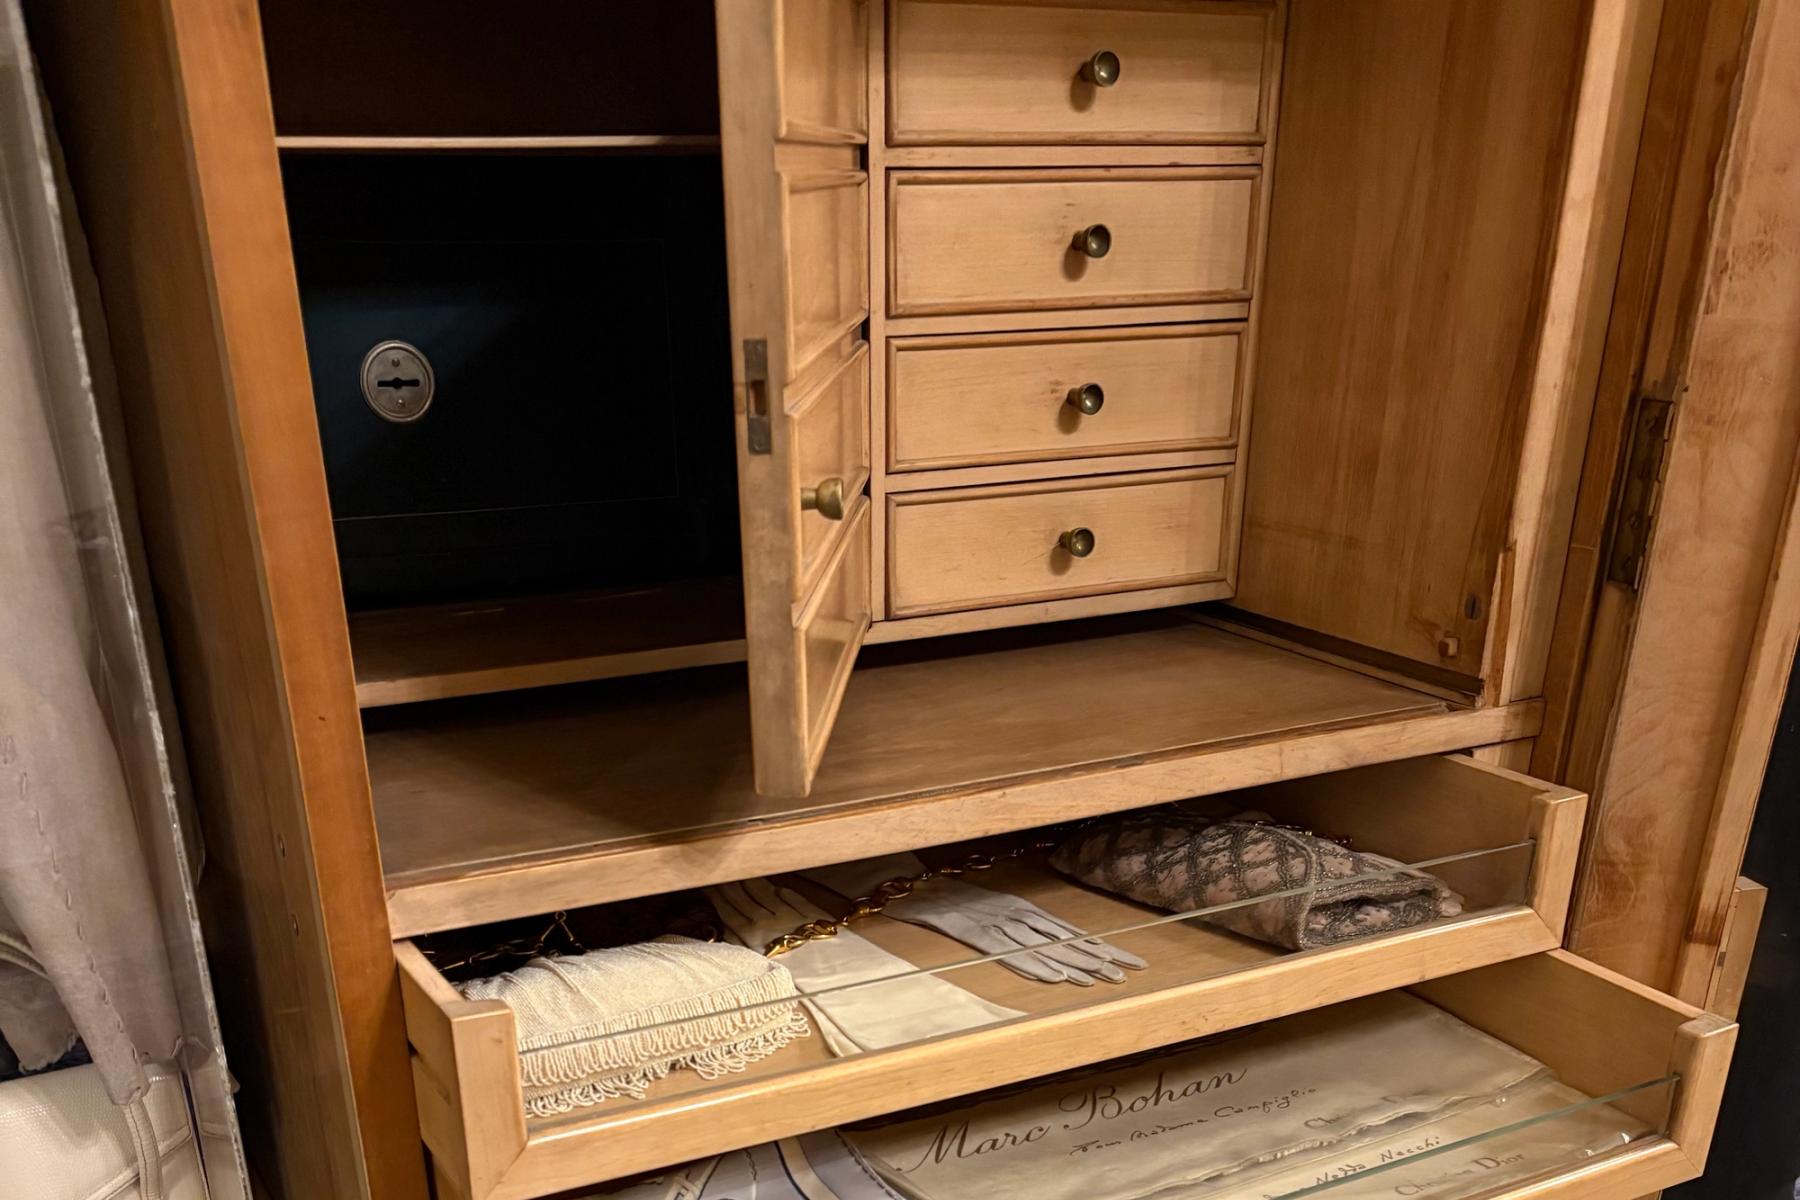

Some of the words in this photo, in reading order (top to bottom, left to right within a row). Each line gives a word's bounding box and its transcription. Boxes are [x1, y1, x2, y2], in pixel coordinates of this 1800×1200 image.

[895, 1120, 1050, 1174] Marc
[1057, 1068, 1247, 1130] Bohan
[1474, 1153, 1526, 1171] Dior
